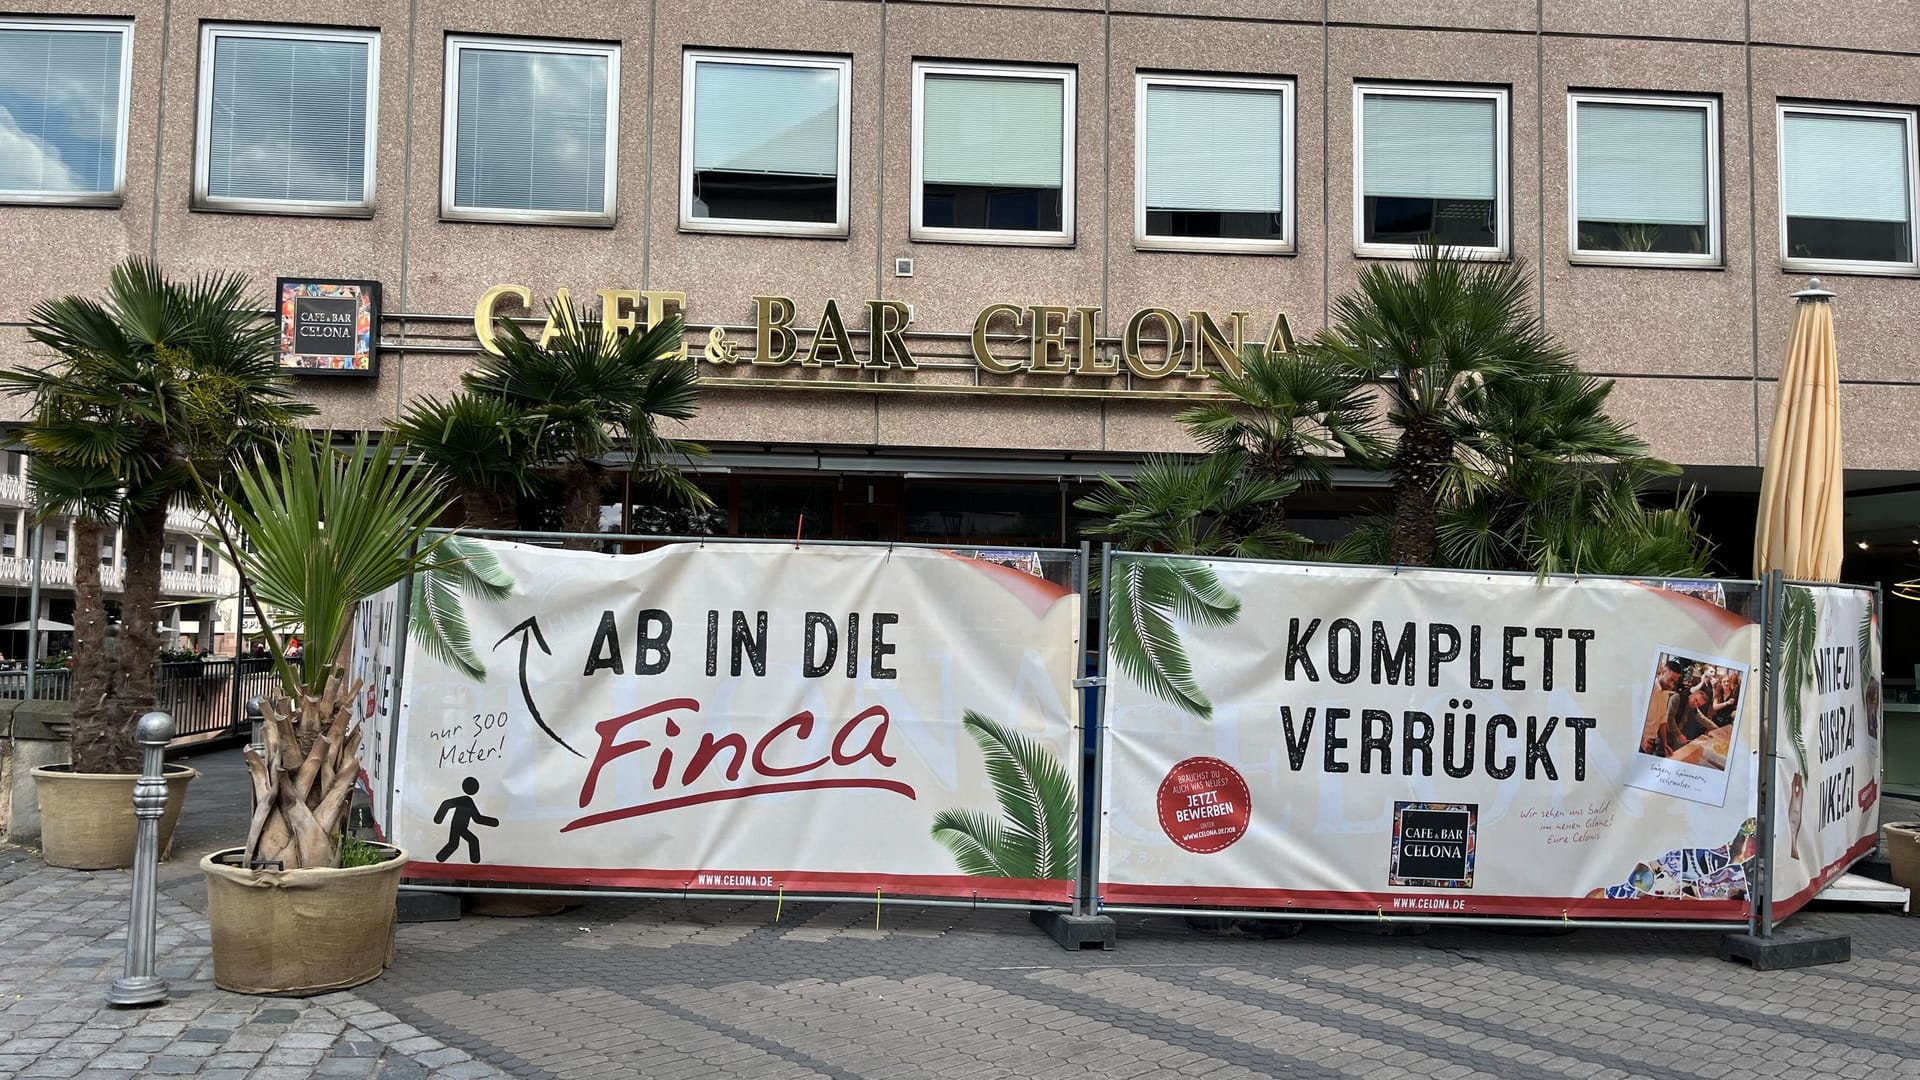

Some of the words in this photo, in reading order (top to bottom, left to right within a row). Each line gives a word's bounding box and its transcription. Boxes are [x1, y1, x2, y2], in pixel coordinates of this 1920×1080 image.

[300, 312, 326, 322] CAFE
[332, 313, 352, 323] BAR
[300, 325, 351, 338] CELONA
[475, 284, 688, 360] CAFE
[703, 326, 739, 364] &
[752, 295, 919, 371] BAR
[971, 302, 1302, 379] CELONA
[583, 609, 673, 677] AB
[705, 610, 768, 677] IN
[802, 611, 899, 680] DIE
[1284, 617, 1595, 693] KOMPLETT
[430, 724, 462, 741] nur
[472, 711, 508, 738] 300
[1279, 698, 1597, 782] VERRÜCKT
[438, 735, 505, 769] Meter!
[579, 697, 897, 808] Finca
[1177, 771, 1208, 784] BRAUCHST
[1211, 770, 1221, 778] DU
[1172, 783, 1190, 794] AUCH
[1190, 780, 1204, 791] WAS
[1205, 778, 1229, 788] NEUES?
[1187, 790, 1218, 807] JETZT
[1176, 802, 1234, 823] BEWERBEN
[1520, 806, 1537, 818] Wir
[1541, 807, 1565, 819] sehen
[1588, 800, 1611, 815] bald
[1405, 827, 1434, 839] CAFE
[1441, 829, 1463, 840] BAR
[1546, 834, 1569, 845] Eure
[1404, 844, 1462, 859] CELONA
[698, 874, 773, 887] WWW.CELONA.DE
[1393, 897, 1465, 910] WWW.CELONA.DE
